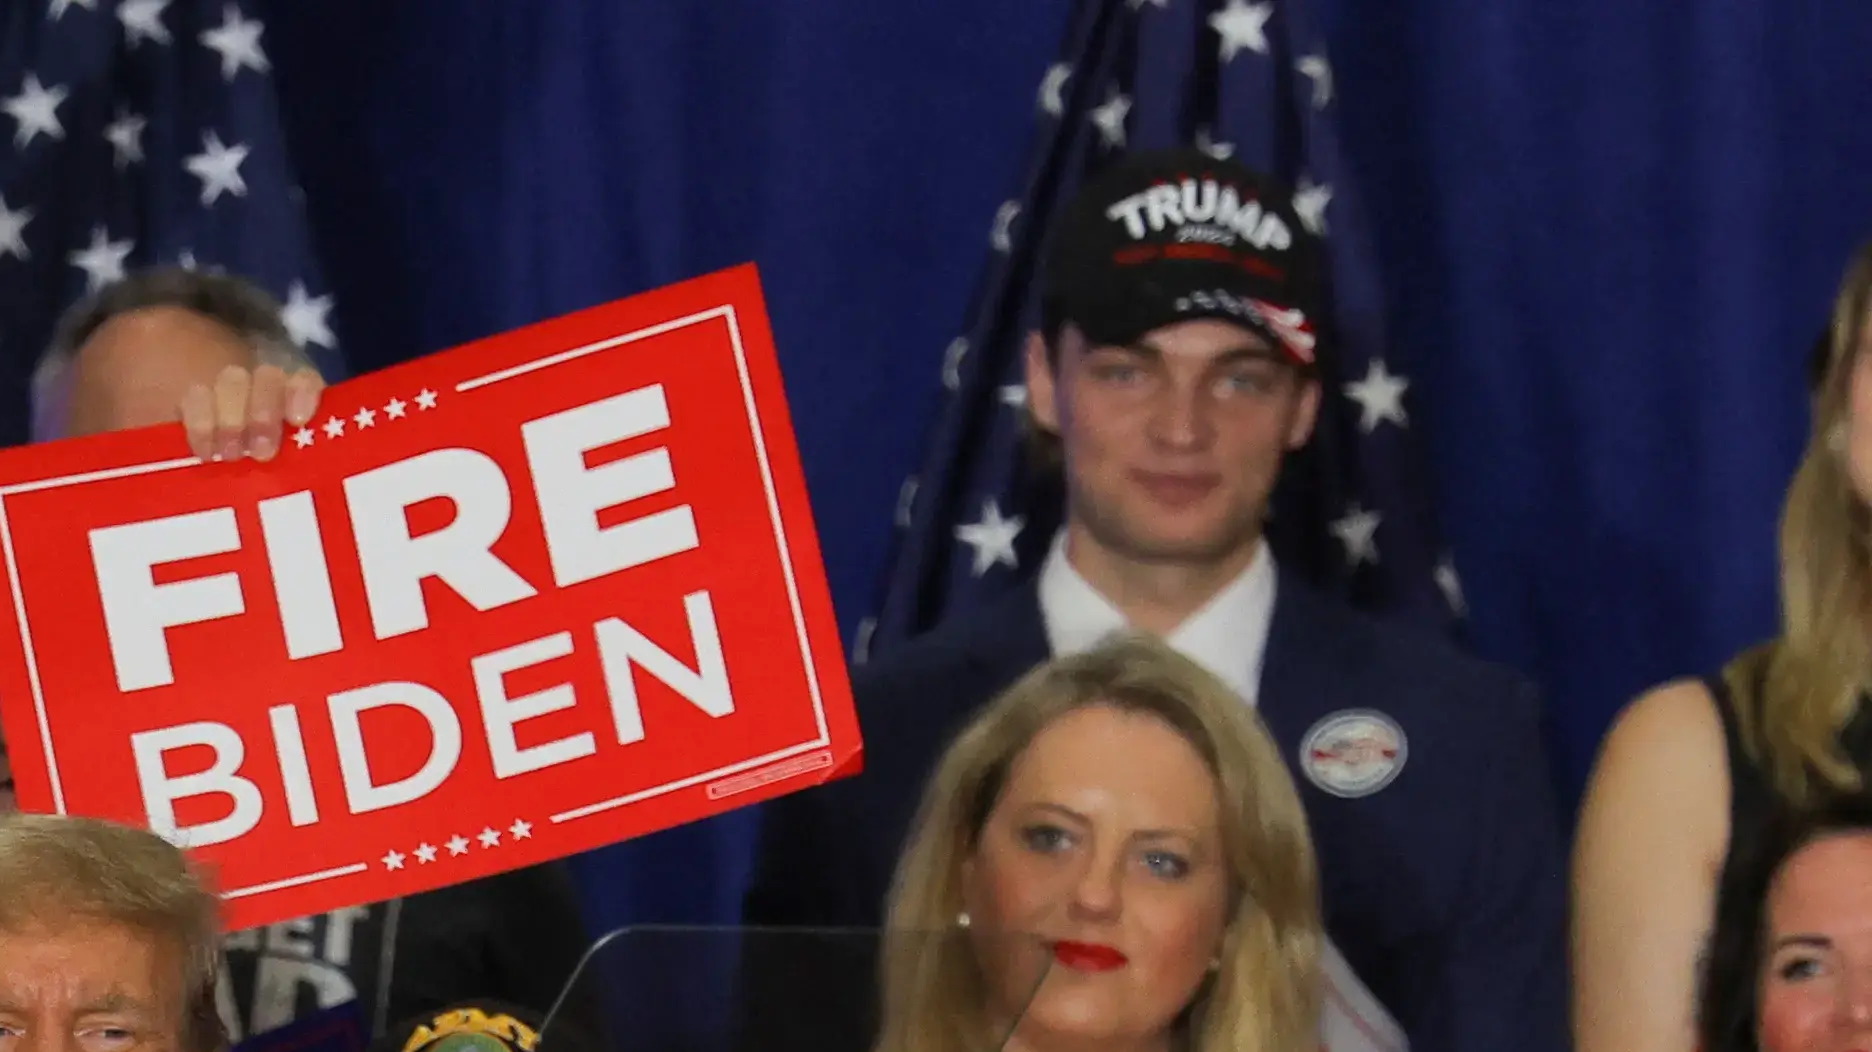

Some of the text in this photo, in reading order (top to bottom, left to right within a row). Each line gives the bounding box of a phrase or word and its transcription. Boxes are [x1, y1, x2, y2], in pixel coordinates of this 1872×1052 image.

[1107, 177, 1292, 250] TRUMP
[87, 383, 700, 693] FIRE
[130, 589, 736, 851] BIDEN
